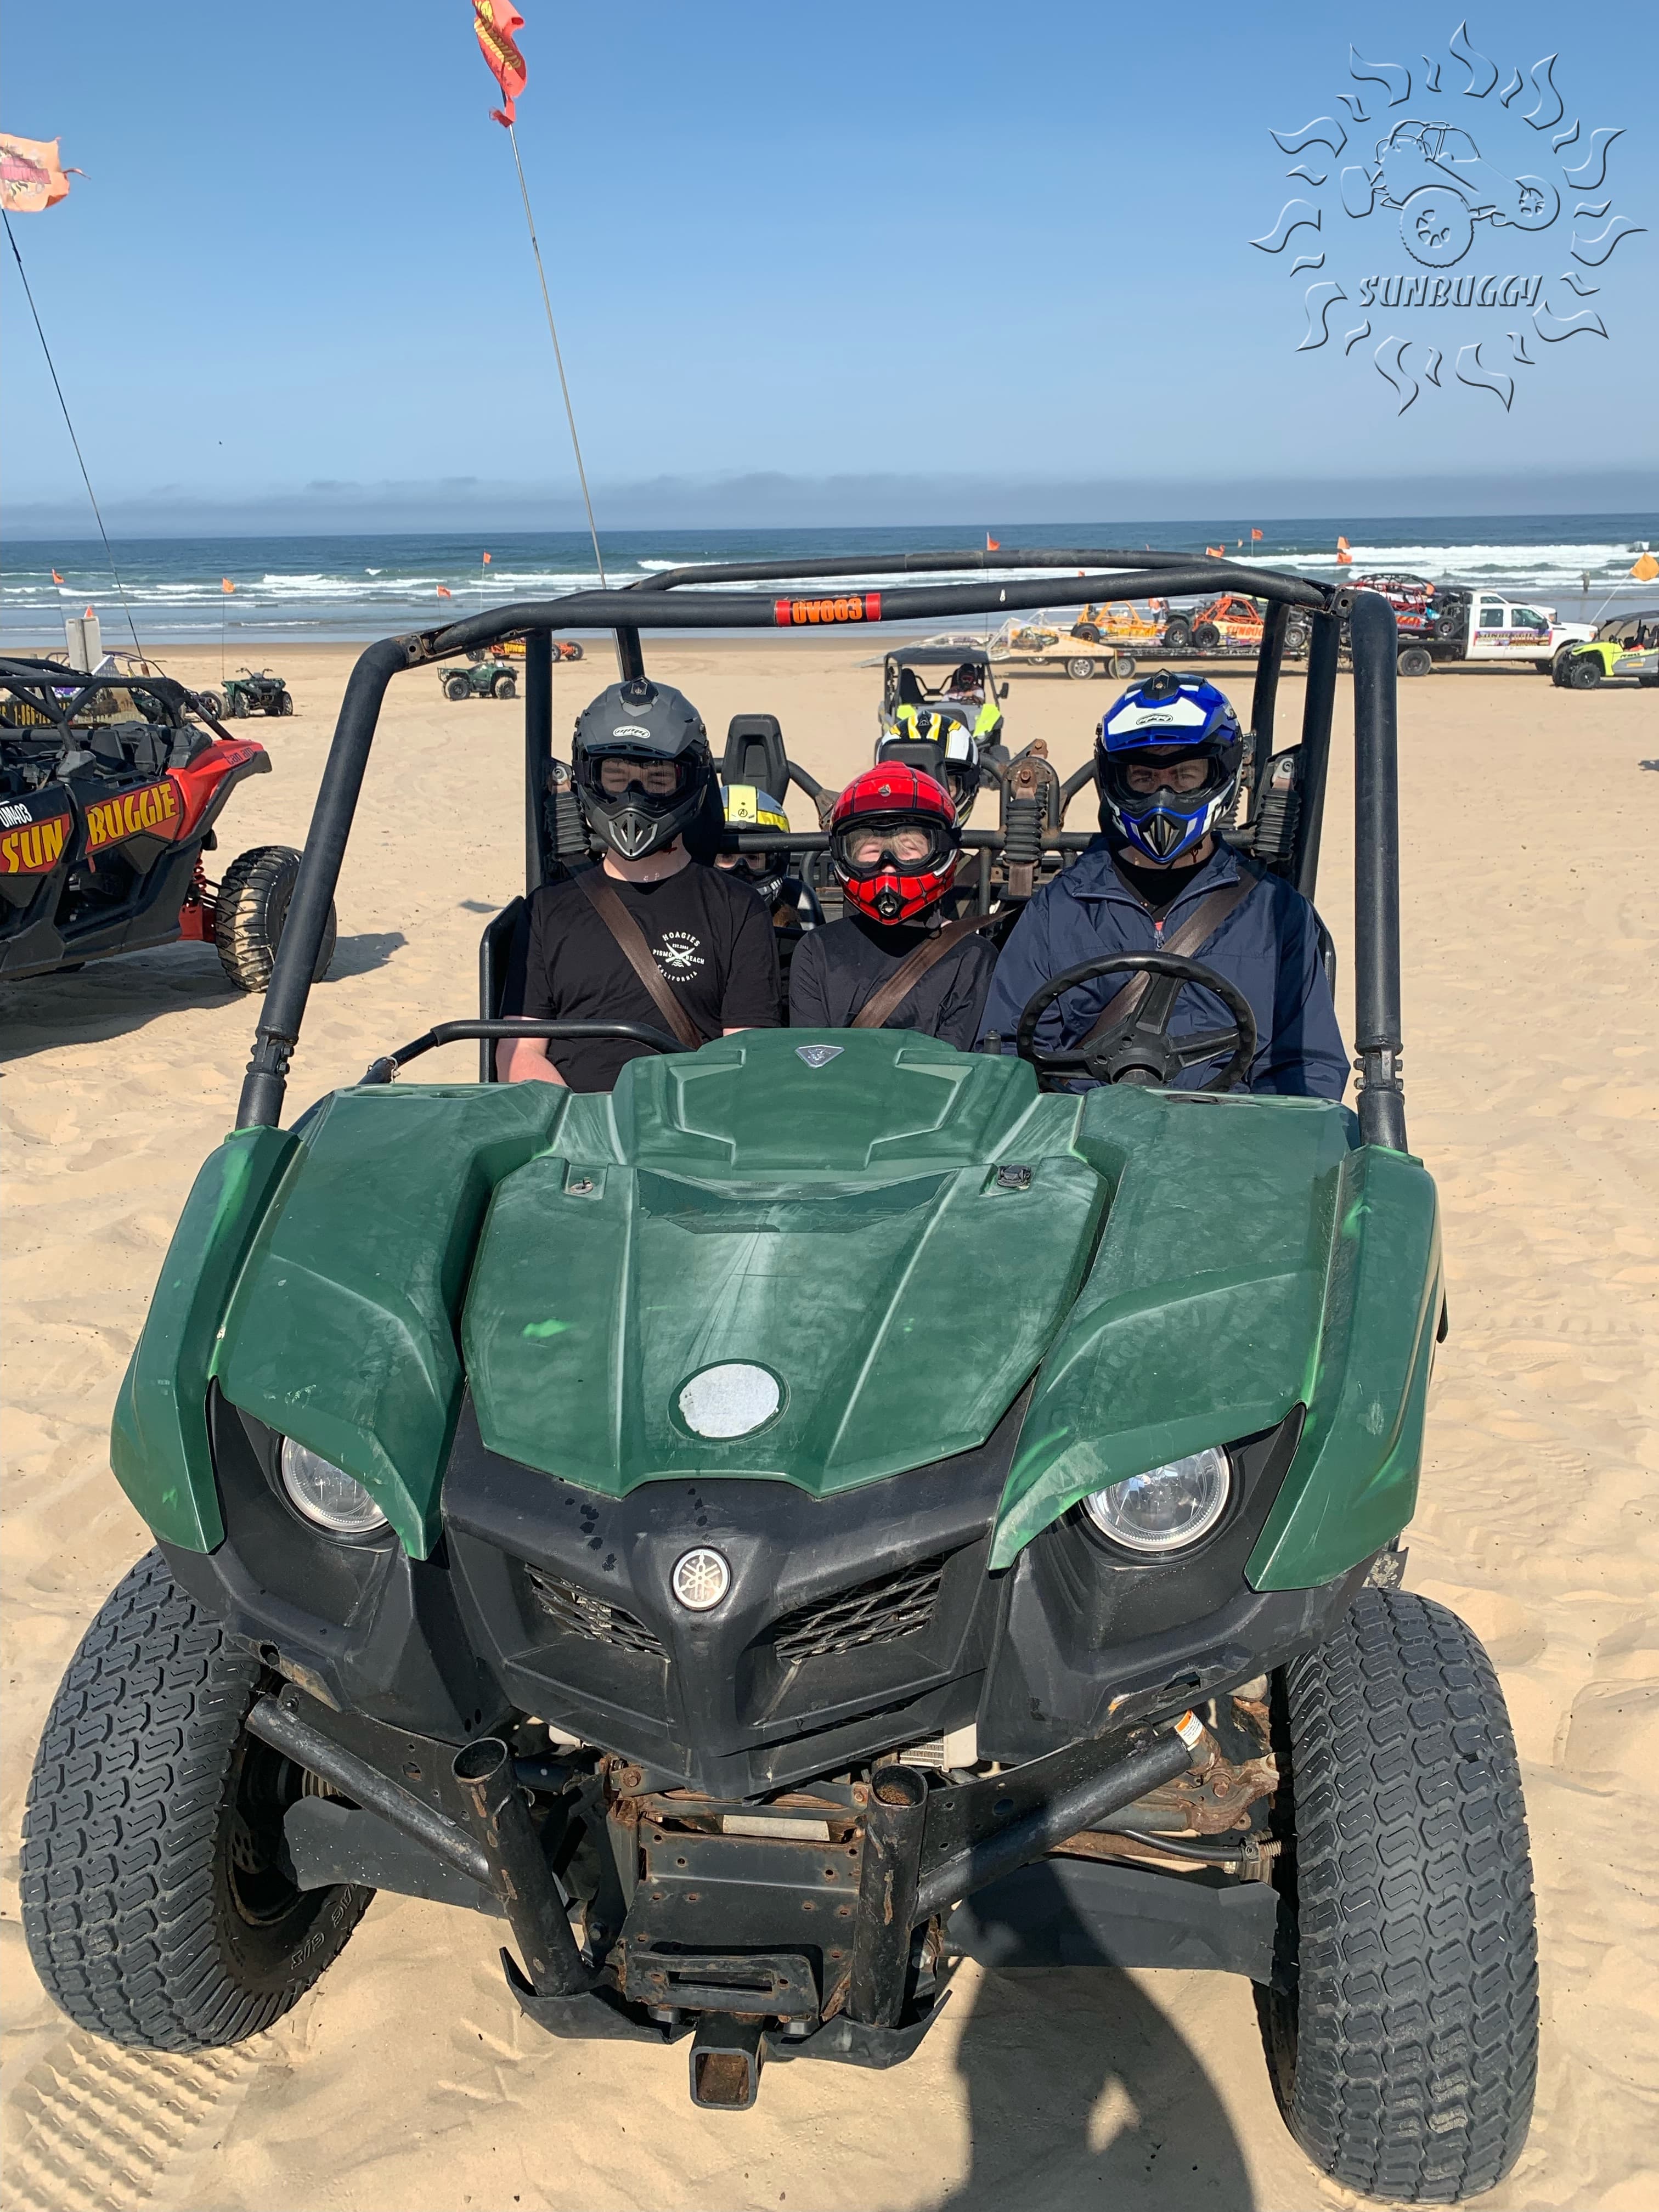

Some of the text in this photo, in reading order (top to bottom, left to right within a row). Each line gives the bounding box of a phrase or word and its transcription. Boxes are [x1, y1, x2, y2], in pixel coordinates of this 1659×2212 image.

[2, 783, 176, 873] SUN BUGGIE
[662, 931, 700, 947] HOAGIES
[652, 949, 705, 965] PISMO BEACH
[658, 964, 698, 982] CALIFORNIA
